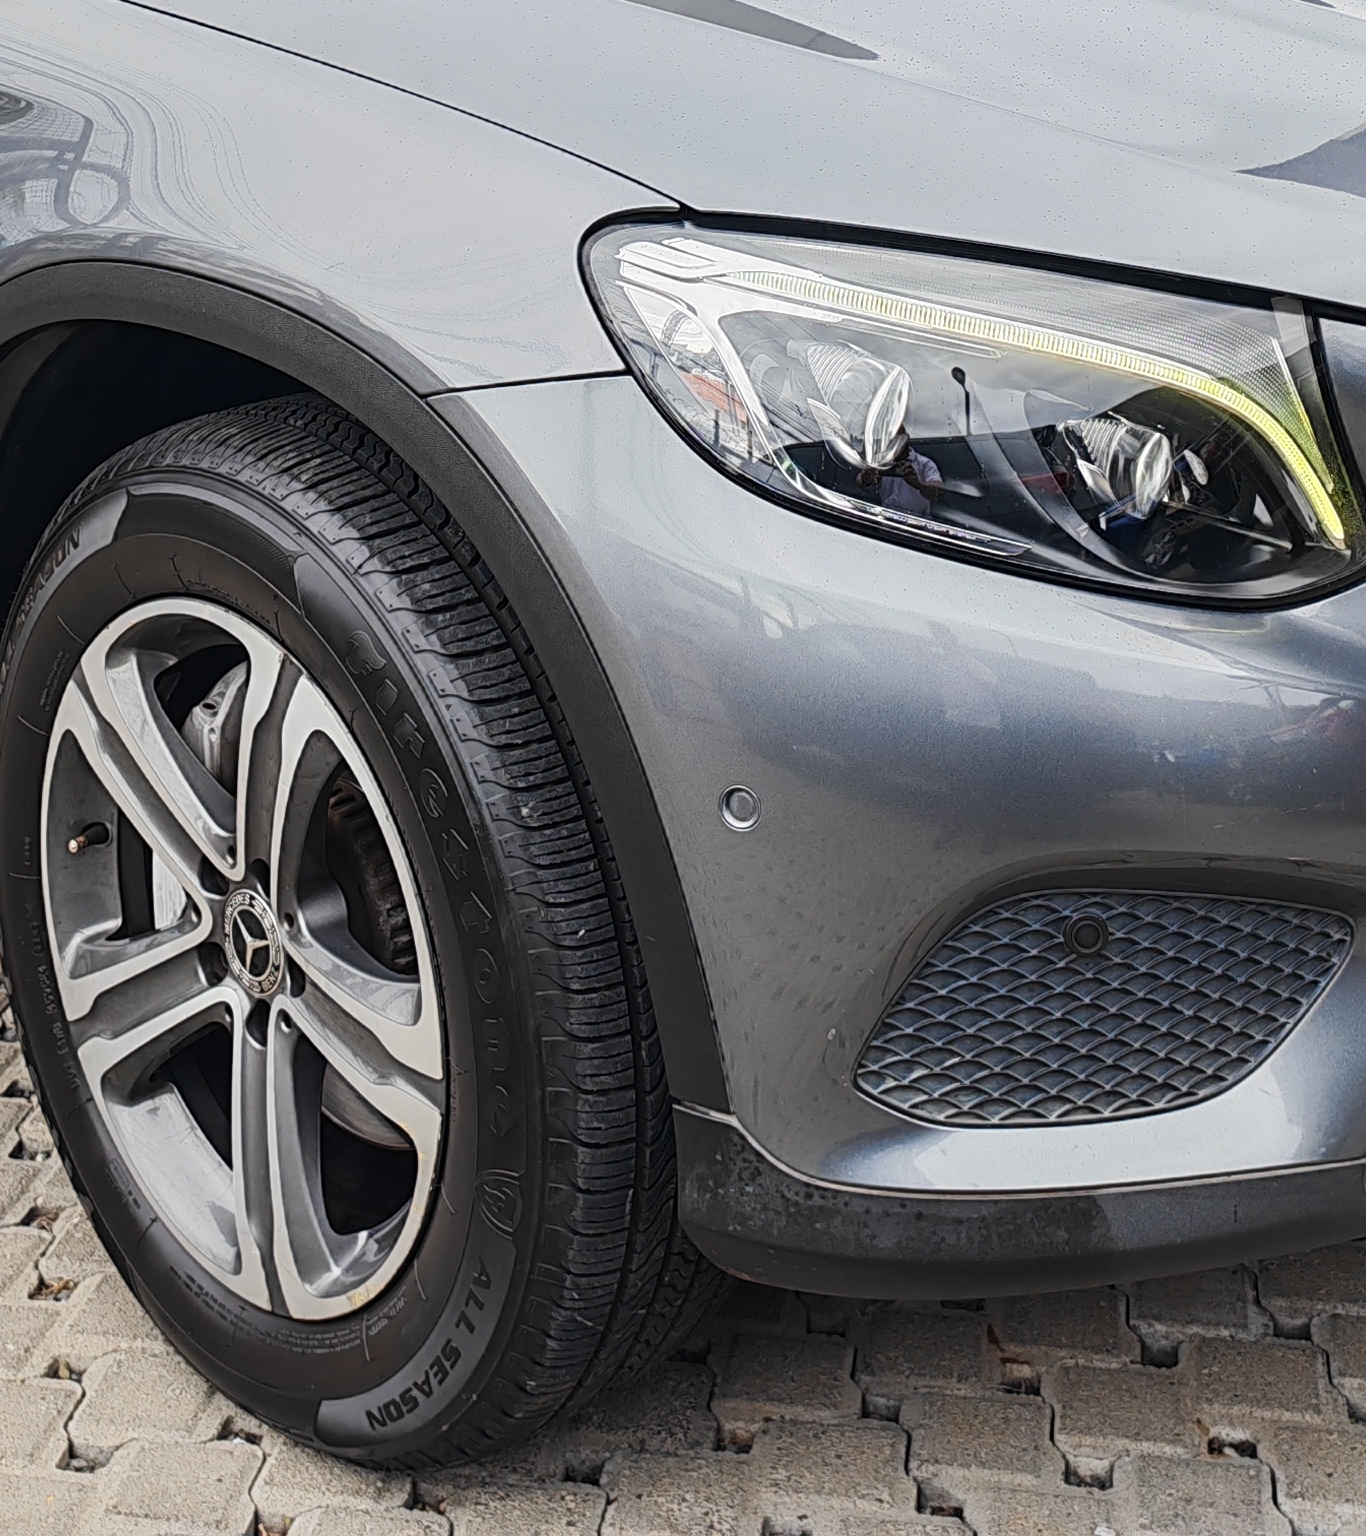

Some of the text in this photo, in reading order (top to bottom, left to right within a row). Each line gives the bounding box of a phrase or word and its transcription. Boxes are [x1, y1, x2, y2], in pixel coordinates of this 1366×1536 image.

[223, 893, 251, 936] MERCEDES
[455, 1255, 493, 1335] ALL
[364, 1337, 463, 1431] SEASON
